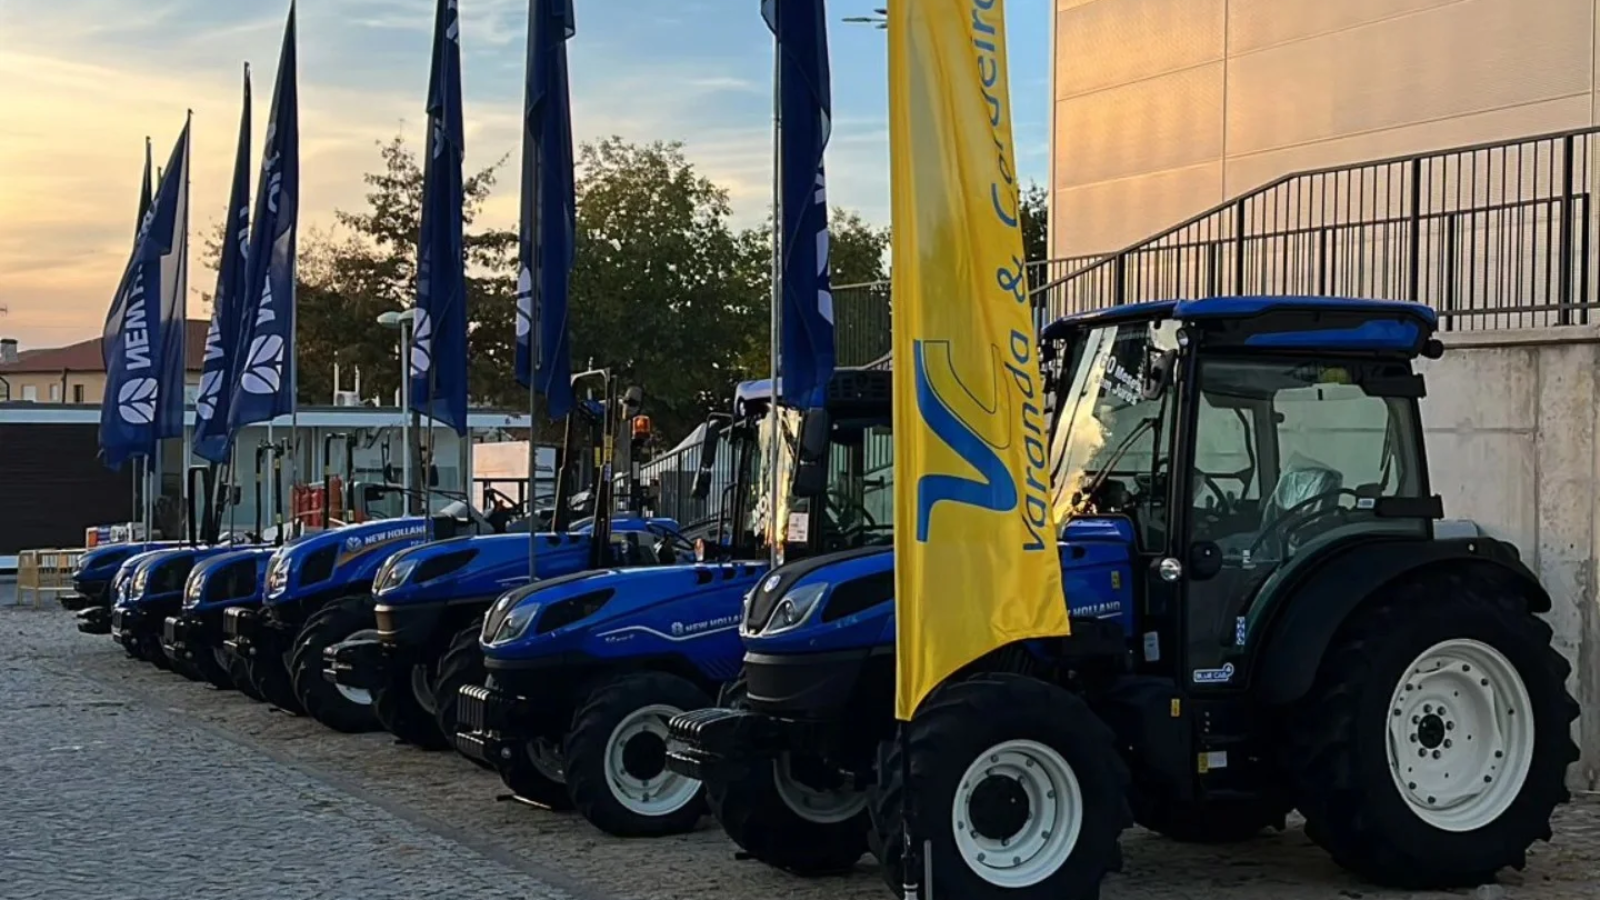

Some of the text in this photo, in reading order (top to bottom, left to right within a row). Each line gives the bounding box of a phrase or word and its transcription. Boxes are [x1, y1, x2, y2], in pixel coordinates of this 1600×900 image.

[996, 255, 1025, 303] &
[1004, 329, 1046, 551] Varanda
[364, 532, 386, 545] NEW
